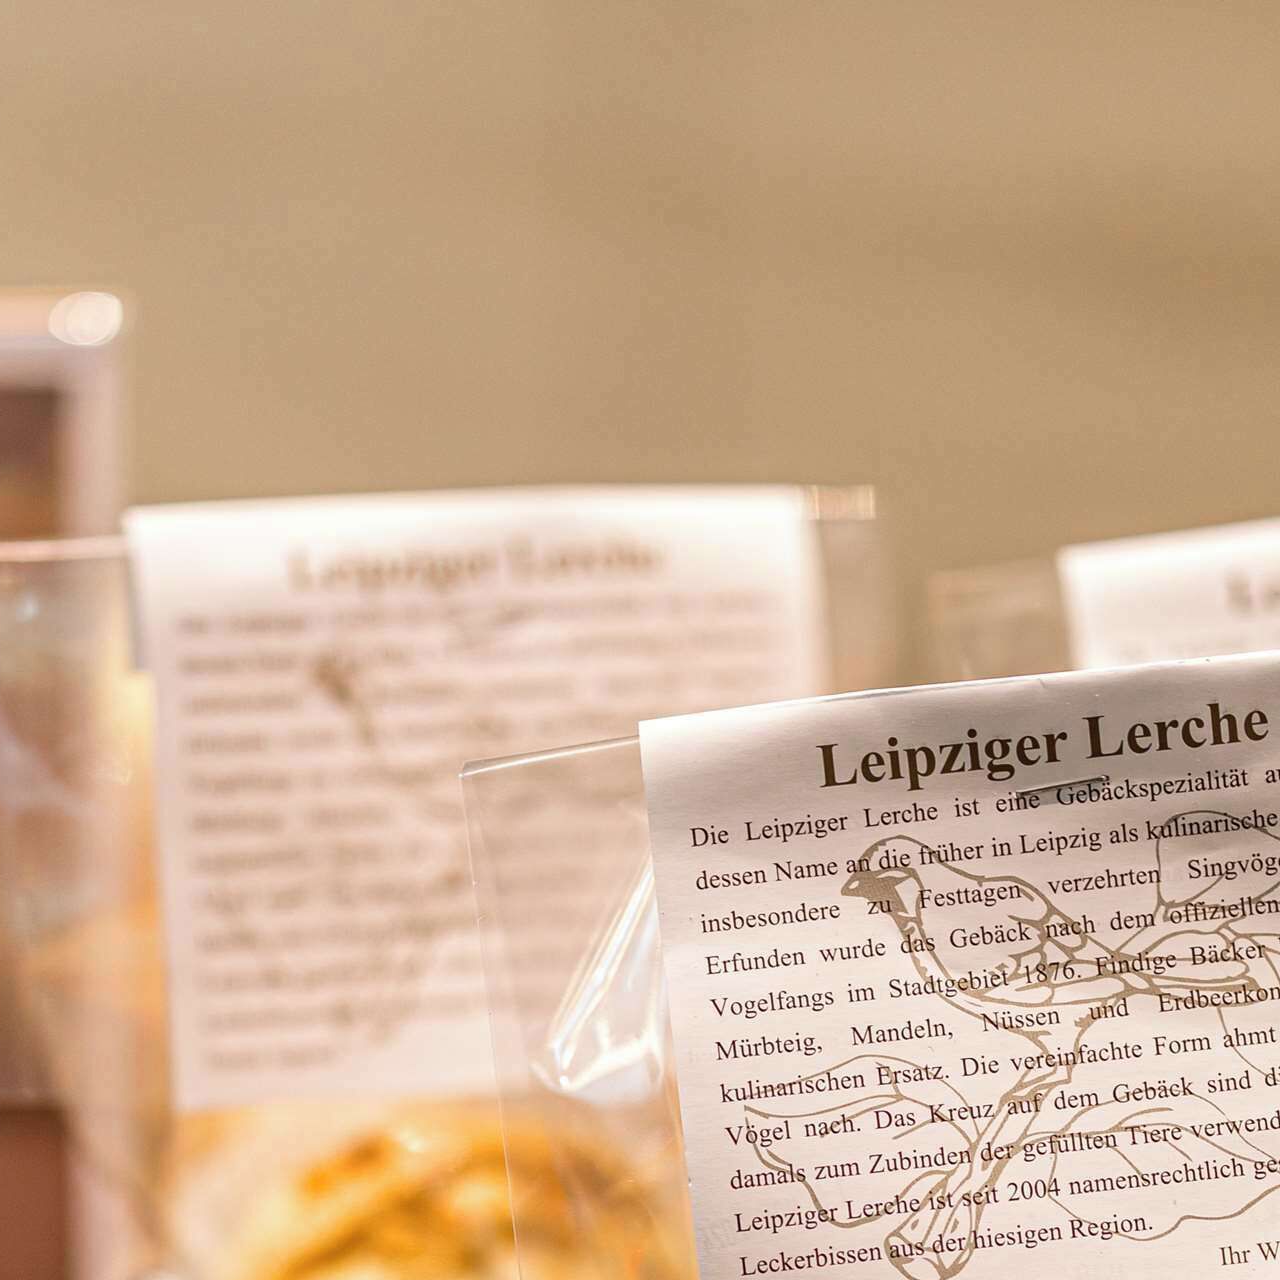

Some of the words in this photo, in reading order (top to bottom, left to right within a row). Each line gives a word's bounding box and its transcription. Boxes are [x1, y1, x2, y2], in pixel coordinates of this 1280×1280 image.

[815, 728, 1068, 792] Leipziger
[1081, 702, 1269, 760] Lerche
[690, 825, 729, 847] Die
[744, 814, 848, 843] Leipziger
[863, 802, 938, 828] Lerche
[954, 797, 980, 818] ist
[995, 791, 1042, 813] eine
[1056, 769, 1249, 806] Gebäckspezialität
[695, 869, 768, 890] dessen
[773, 861, 838, 882] Name
[846, 857, 872, 874] an
[878, 848, 913, 873] die
[918, 842, 985, 868] früher
[991, 837, 1013, 857] in
[1019, 827, 1102, 856] Leipzig
[1109, 823, 1139, 844] als
[1146, 808, 1278, 840] kulinarische
[701, 902, 841, 933] insbesondere
[867, 899, 893, 915] zu
[919, 881, 1023, 909] Festtagen
[1047, 868, 1161, 894] verzehrten
[705, 948, 806, 975] Erfunden
[819, 938, 886, 962] wurde
[900, 929, 936, 954] das
[949, 921, 1032, 949] Gebäck
[1045, 915, 1096, 940] nach
[1110, 907, 1157, 930] dem
[1168, 895, 1280, 925] offiziellen
[709, 990, 834, 1020] Vogelfangs
[847, 983, 876, 1003] im
[888, 969, 1009, 998] Stadtgebiet
[1024, 956, 1084, 984] 1876.
[1095, 950, 1177, 979] Findige
[1190, 941, 1266, 966] Bäcker
[715, 1032, 823, 1061] Mürbteig,
[851, 1018, 953, 1046] Mandeln,
[980, 1010, 1061, 1032] Nüssen
[1089, 996, 1130, 1021] und
[719, 1071, 865, 1103] kulinarischen
[876, 1065, 950, 1086] Ersatz.
[960, 1055, 1000, 1077] Die
[1010, 1041, 1142, 1071] vereinfachte
[1153, 1036, 1212, 1056] Form
[1223, 1026, 1276, 1048] ahmt
[724, 1118, 792, 1148] Vögel
[804, 1113, 861, 1138] nach.
[873, 1110, 916, 1130] Das
[928, 1103, 995, 1124] Kreuz
[1007, 1092, 1043, 1116] auf
[1054, 1090, 1102, 1110] dem
[1112, 1076, 1194, 1104] Gebäck
[1207, 1069, 1252, 1094] sind
[730, 1163, 806, 1190] damals
[814, 1162, 861, 1180] zum
[869, 1146, 973, 1174] Zubinden
[980, 1141, 1015, 1162] der
[1022, 1131, 1118, 1163] gefüllten
[1123, 1124, 1182, 1146] Tiere
[734, 1205, 839, 1234] Leipziger
[845, 1194, 921, 1220] Lerche
[928, 1190, 954, 1210] ist
[961, 1184, 999, 1207] seit
[1007, 1177, 1061, 1202] 2004
[1068, 1157, 1246, 1195] namensrechtlich
[740, 1245, 883, 1277] Leckerbissen
[889, 1241, 925, 1259] aus
[932, 1233, 966, 1255] der
[971, 1225, 1063, 1250] hiesigen
[1069, 1213, 1153, 1240] Region.
[1220, 1245, 1251, 1266] Ihr
